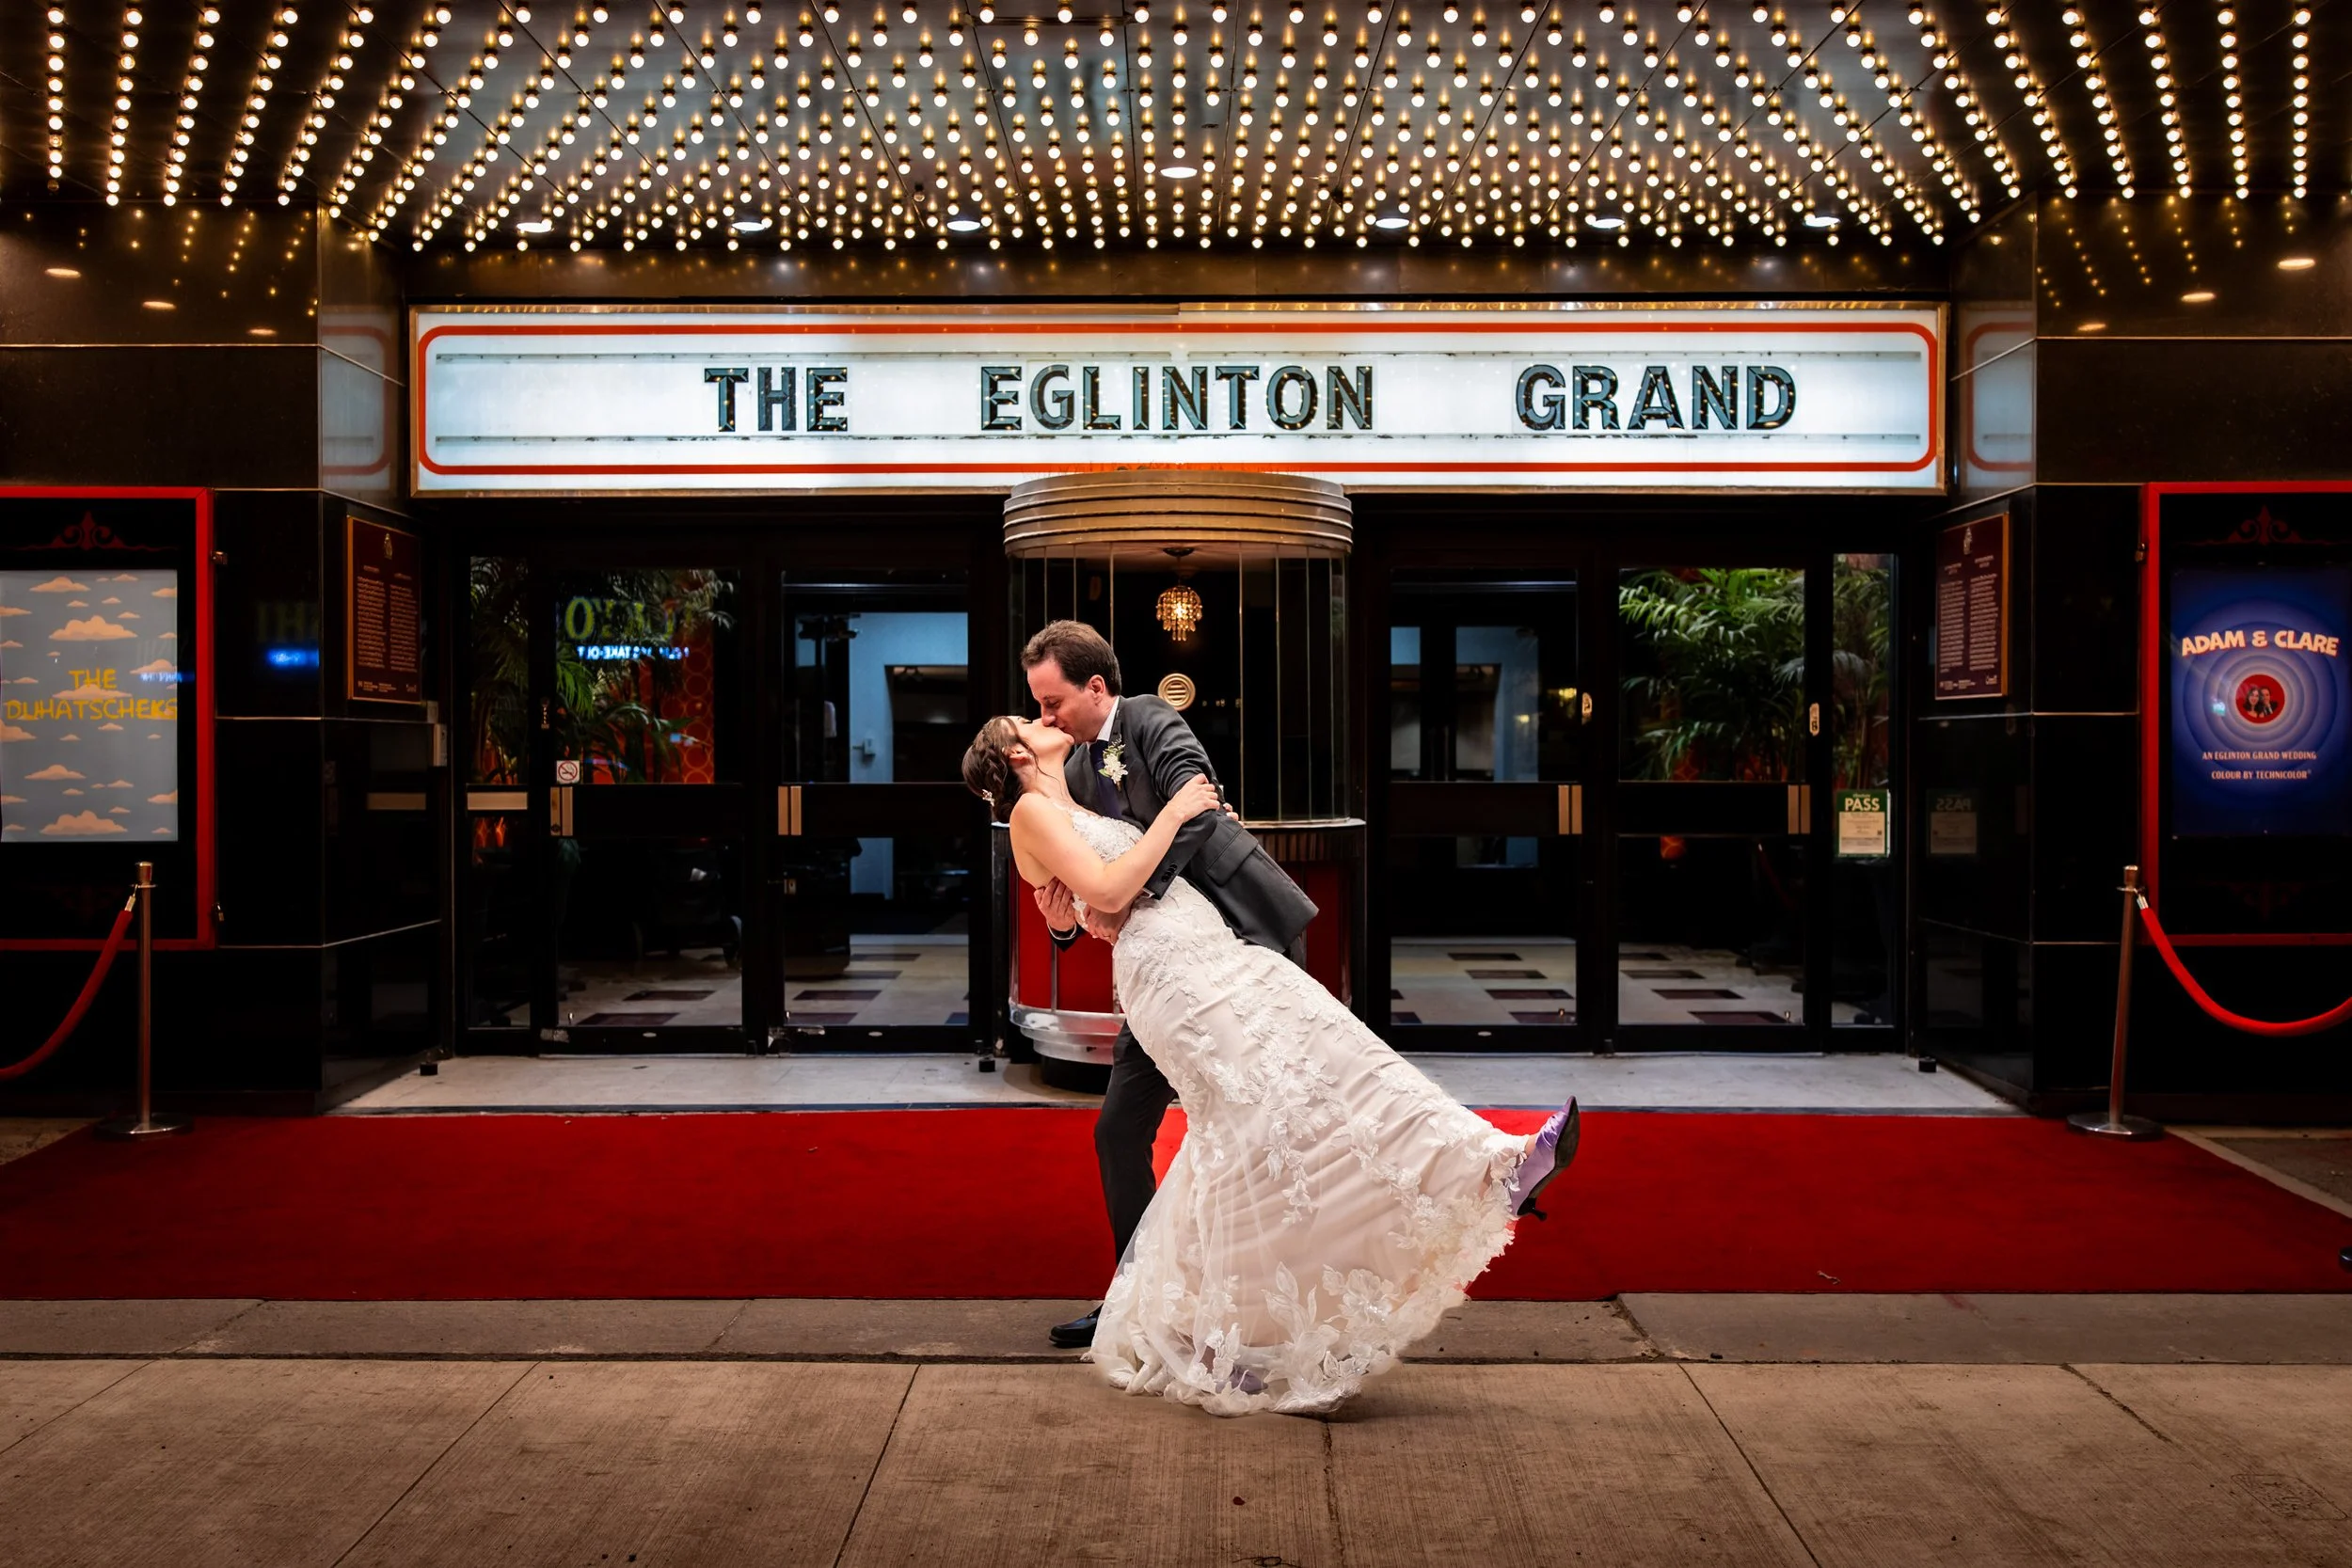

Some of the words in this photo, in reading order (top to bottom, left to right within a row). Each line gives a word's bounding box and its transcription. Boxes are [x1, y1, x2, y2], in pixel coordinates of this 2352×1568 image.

[705, 366, 848, 432] THE
[981, 364, 1374, 432] EGLINTON
[1515, 363, 1797, 431] GRAND
[2181, 630, 2246, 657] ADAM
[2251, 630, 2267, 647] &
[2274, 630, 2340, 657] CLARE
[69, 668, 118, 689] THE
[2202, 752, 2213, 760] AN
[2215, 752, 2250, 760] EGLINTON
[2252, 752, 2280, 760] GRAND
[2281, 752, 2316, 760] WEDDING
[2211, 770, 2241, 780] COLOUR
[2243, 770, 2253, 780] BY
[1845, 797, 1881, 811] PASS
